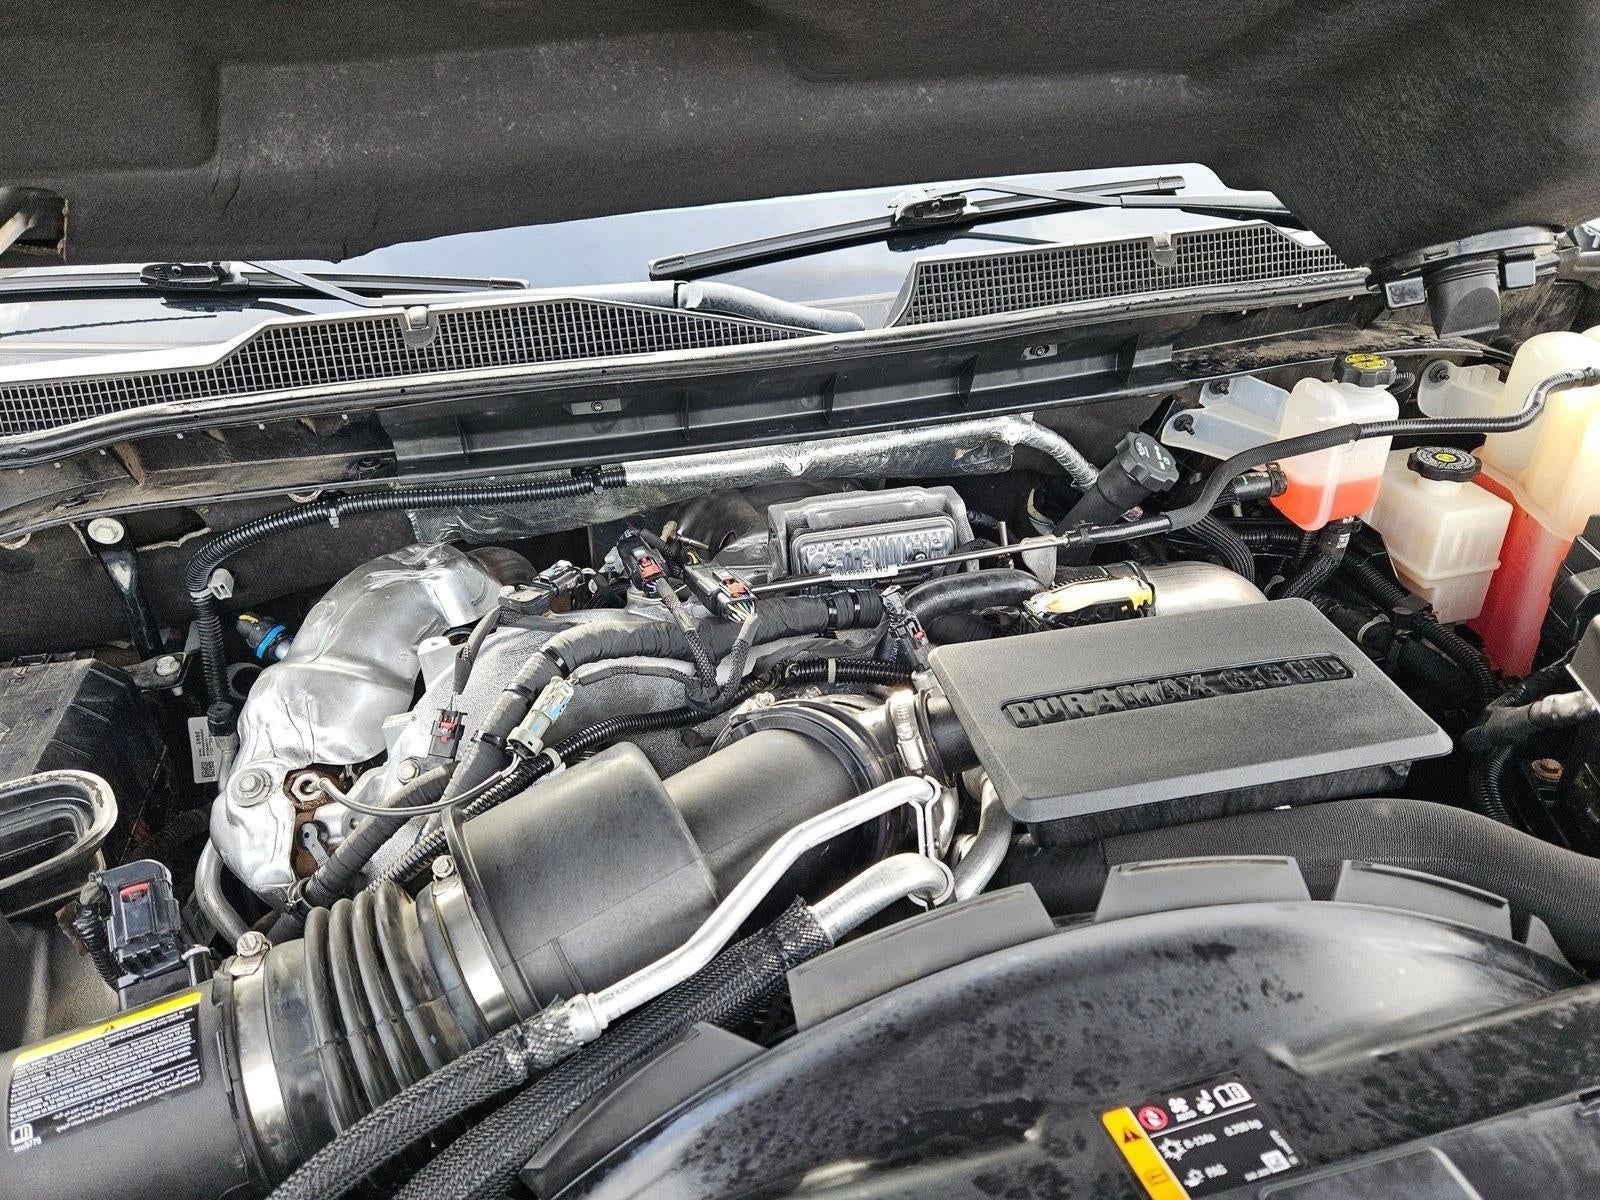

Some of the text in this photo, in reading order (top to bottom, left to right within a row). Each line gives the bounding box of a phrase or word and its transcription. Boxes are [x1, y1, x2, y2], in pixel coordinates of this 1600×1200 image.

[1006, 658, 1346, 727] DURAMAX 6.6 HD
